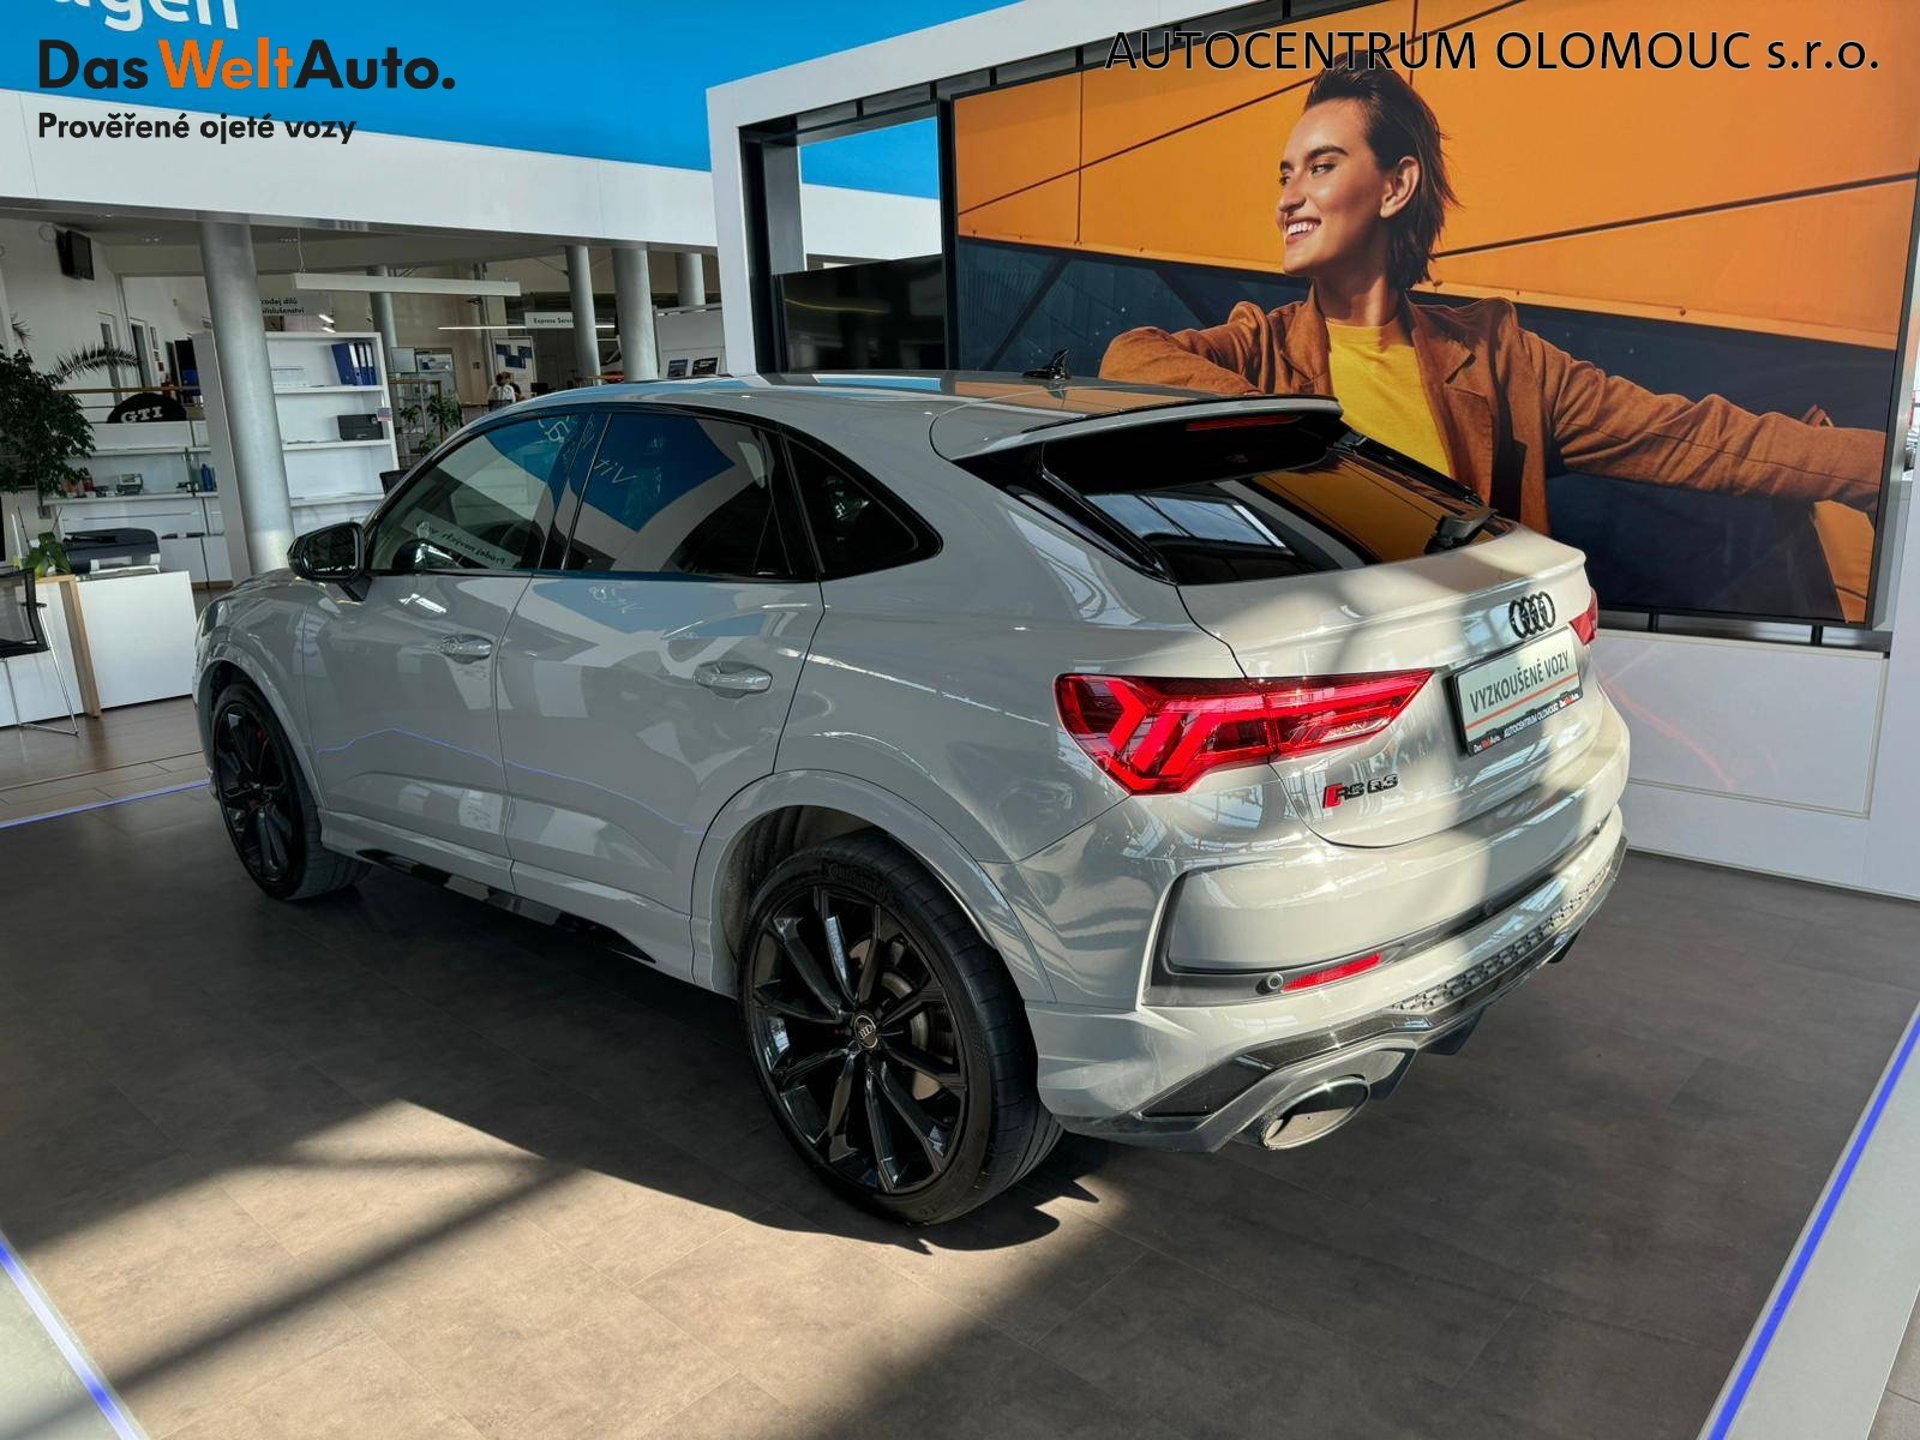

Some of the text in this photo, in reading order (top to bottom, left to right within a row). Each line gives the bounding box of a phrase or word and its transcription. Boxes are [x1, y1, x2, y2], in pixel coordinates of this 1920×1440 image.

[121, 406, 163, 423] GTI
[1469, 650, 1570, 713] VYZKOUŠENÉ VOZY
